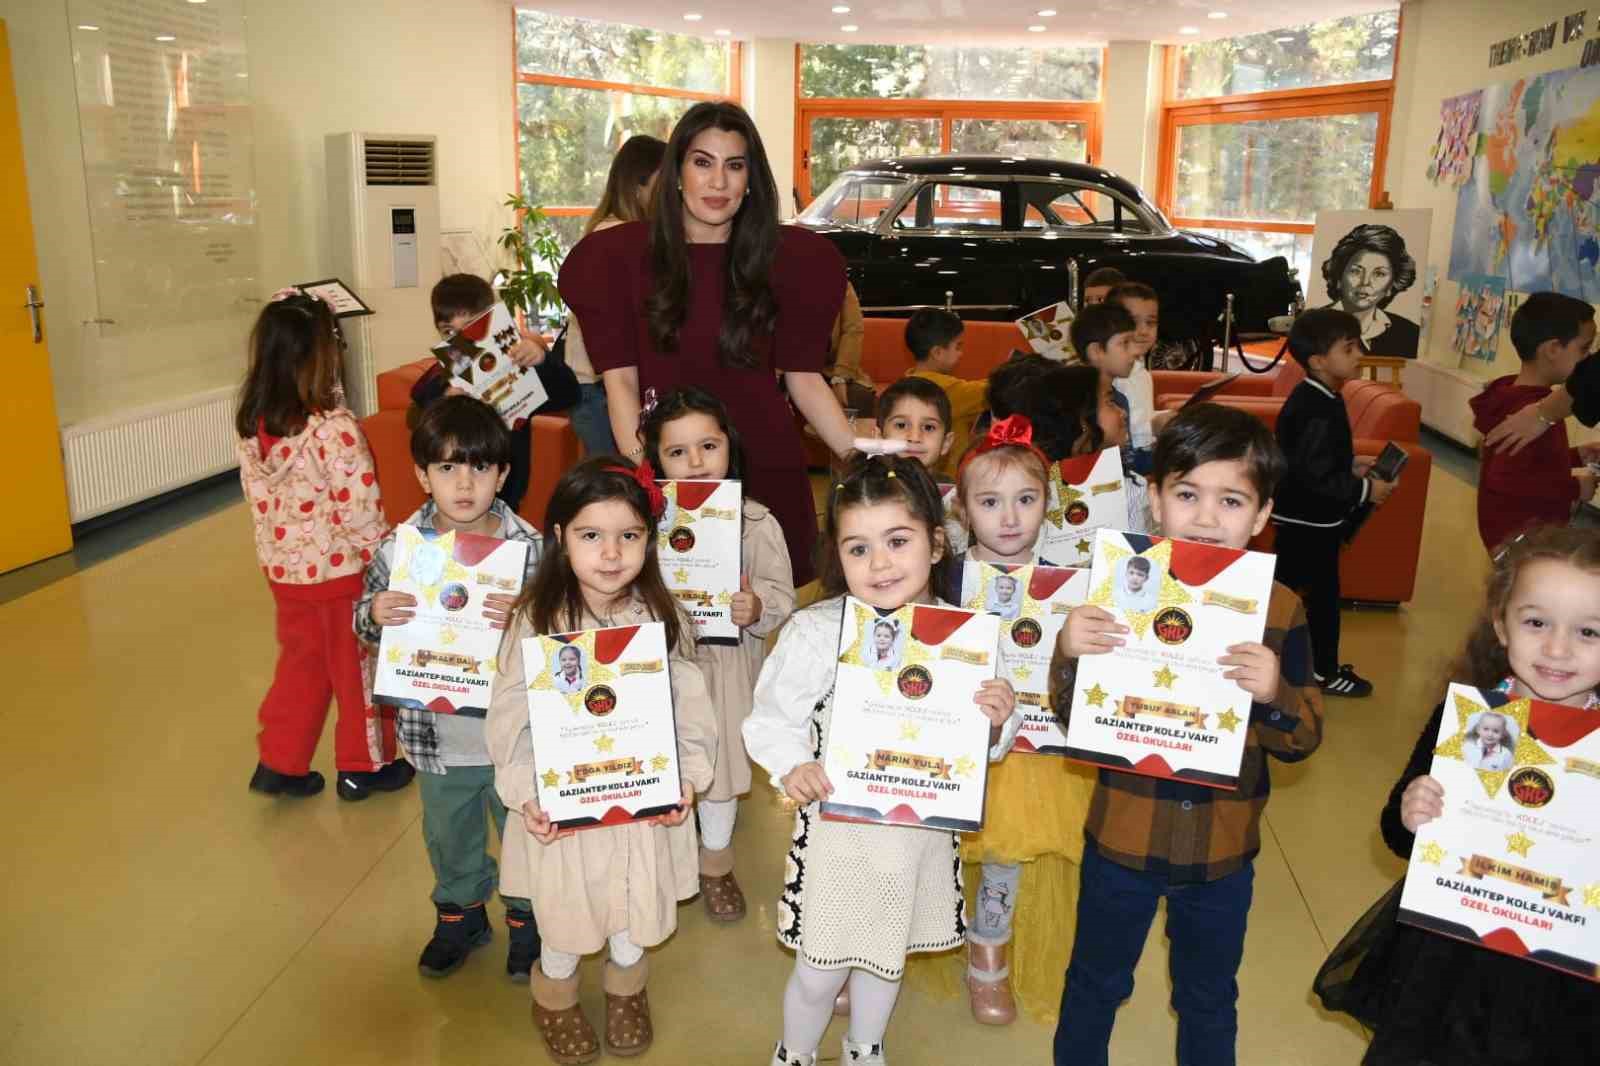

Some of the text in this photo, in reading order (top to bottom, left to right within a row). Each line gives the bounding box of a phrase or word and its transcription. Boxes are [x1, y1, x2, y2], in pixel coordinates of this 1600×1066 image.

[440, 674, 466, 684] KOLEJ
[466, 677, 488, 687] VAKFI
[1023, 714, 1044, 722] OLEJ
[1154, 726, 1186, 738] KOLEJ
[1188, 731, 1218, 744] VAKFI
[1142, 736, 1192, 752] OKULLARI
[608, 780, 635, 790] KOLEJ
[636, 776, 660, 787] VAKFI
[901, 777, 931, 788] KOLEJ
[932, 780, 960, 792] VAKFI
[601, 790, 642, 802] OKULLARI
[891, 787, 937, 800] OKULLARI
[1506, 894, 1546, 914] KOLEJ
[1547, 907, 1586, 926] VAKFI
[1491, 906, 1553, 930] OKULLARI
